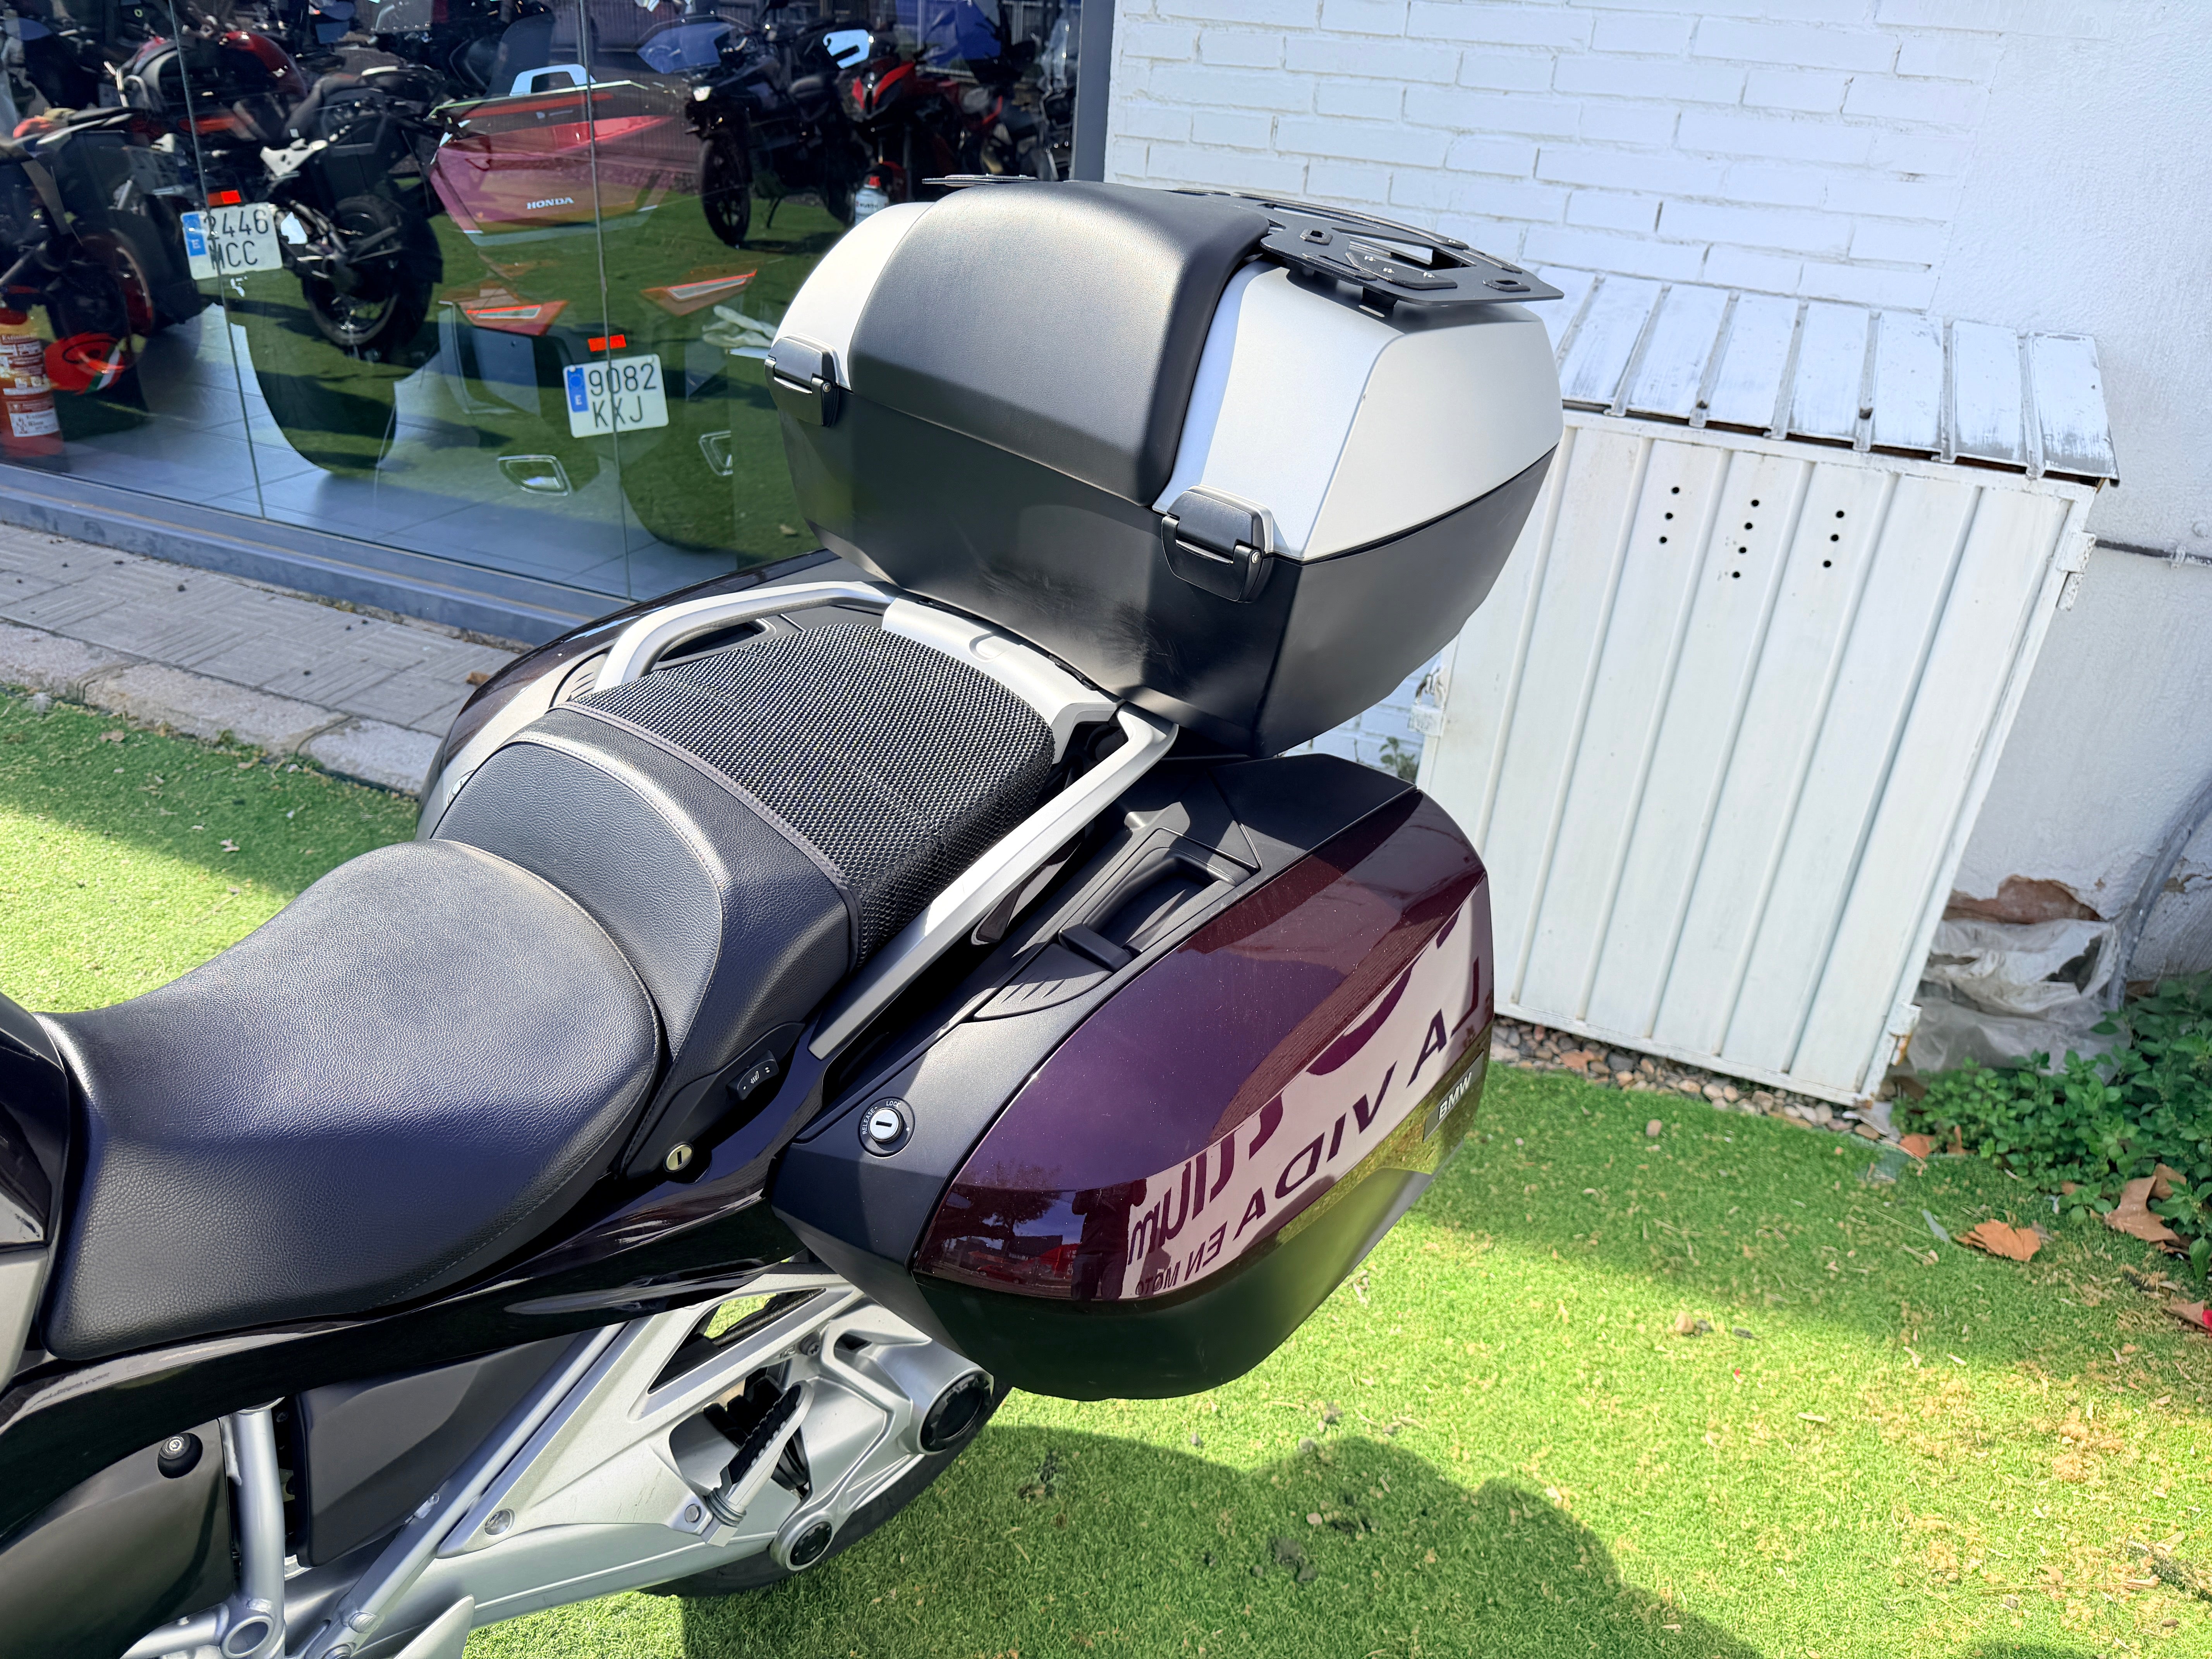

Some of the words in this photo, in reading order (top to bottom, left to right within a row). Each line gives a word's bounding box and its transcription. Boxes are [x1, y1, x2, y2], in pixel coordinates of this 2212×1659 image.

[527, 197, 574, 210] HONDA
[204, 210, 268, 240] 2446
[208, 240, 258, 270] MCC
[589, 362, 657, 396] 9082
[575, 395, 582, 405] E
[1438, 1072, 1472, 1120] BMW
[862, 1108, 875, 1135] RELEASE
